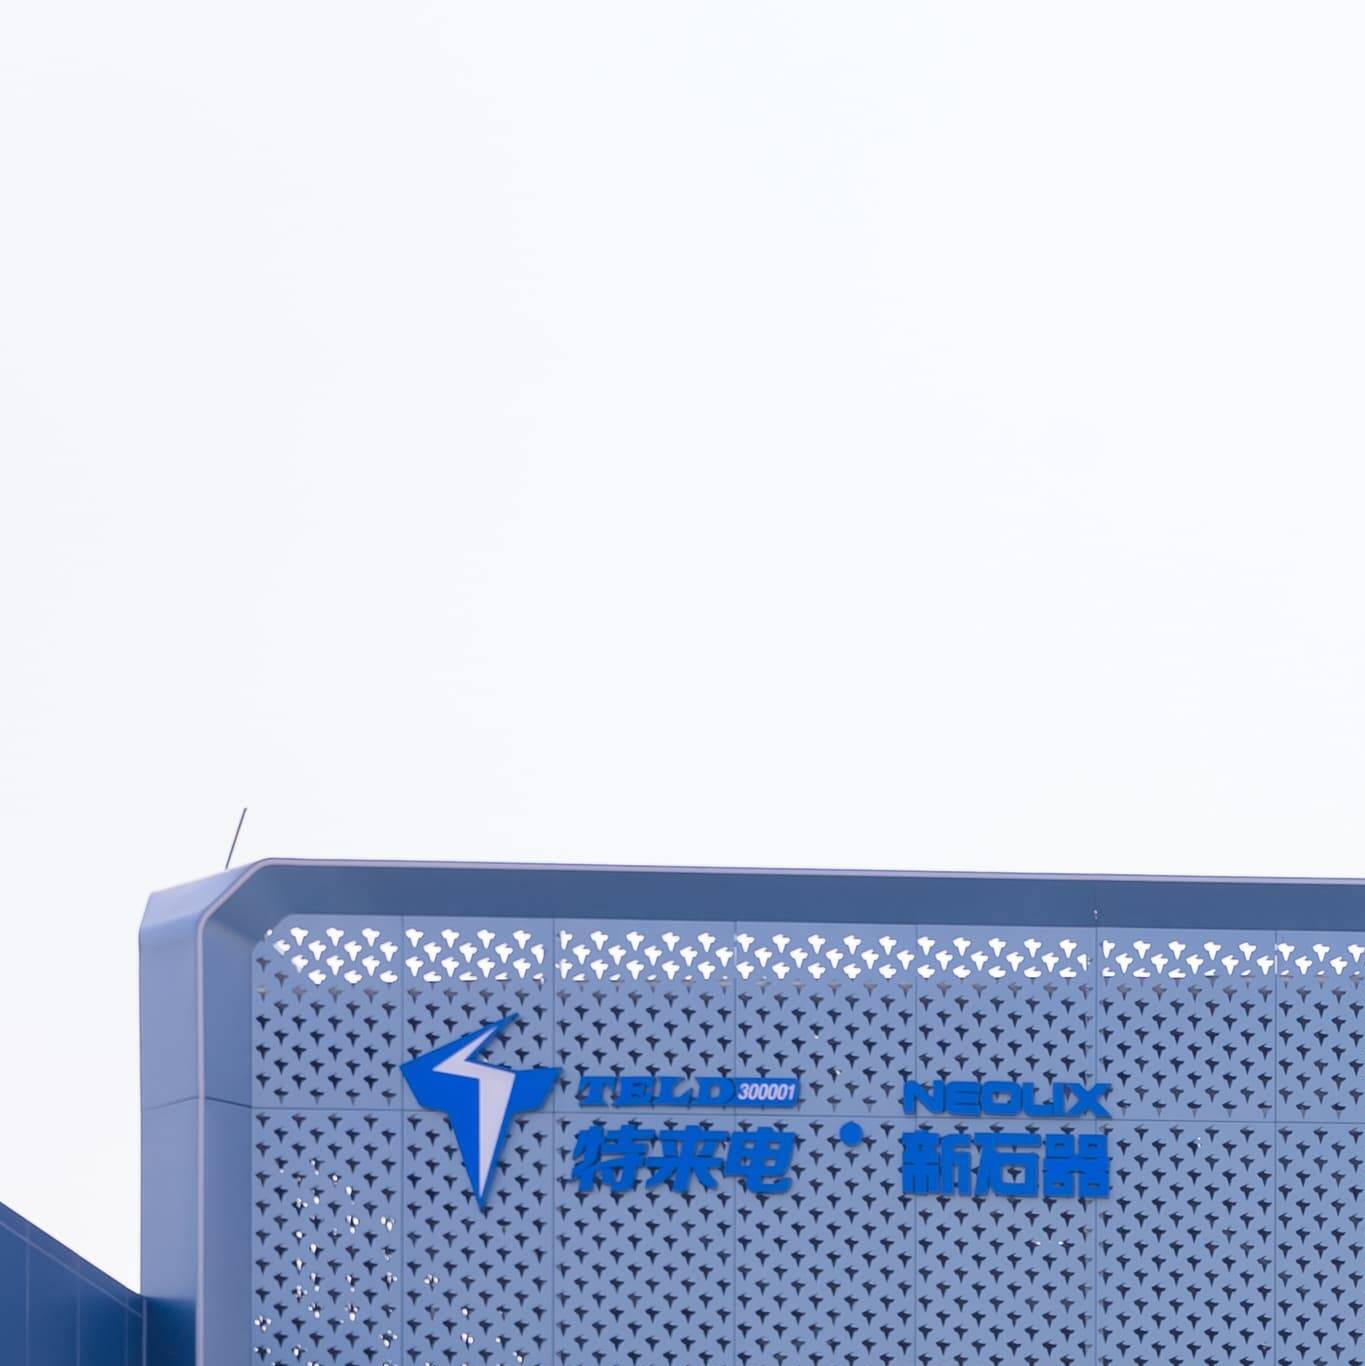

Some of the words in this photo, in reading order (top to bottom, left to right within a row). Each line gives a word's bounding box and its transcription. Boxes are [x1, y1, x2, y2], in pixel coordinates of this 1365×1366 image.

[578, 1076, 735, 1108] TELD
[738, 1083, 796, 1101] 300001
[903, 1079, 1112, 1119] NEOLIX
[571, 1124, 797, 1194] 特来电
[902, 1130, 1110, 1198] 新石器
